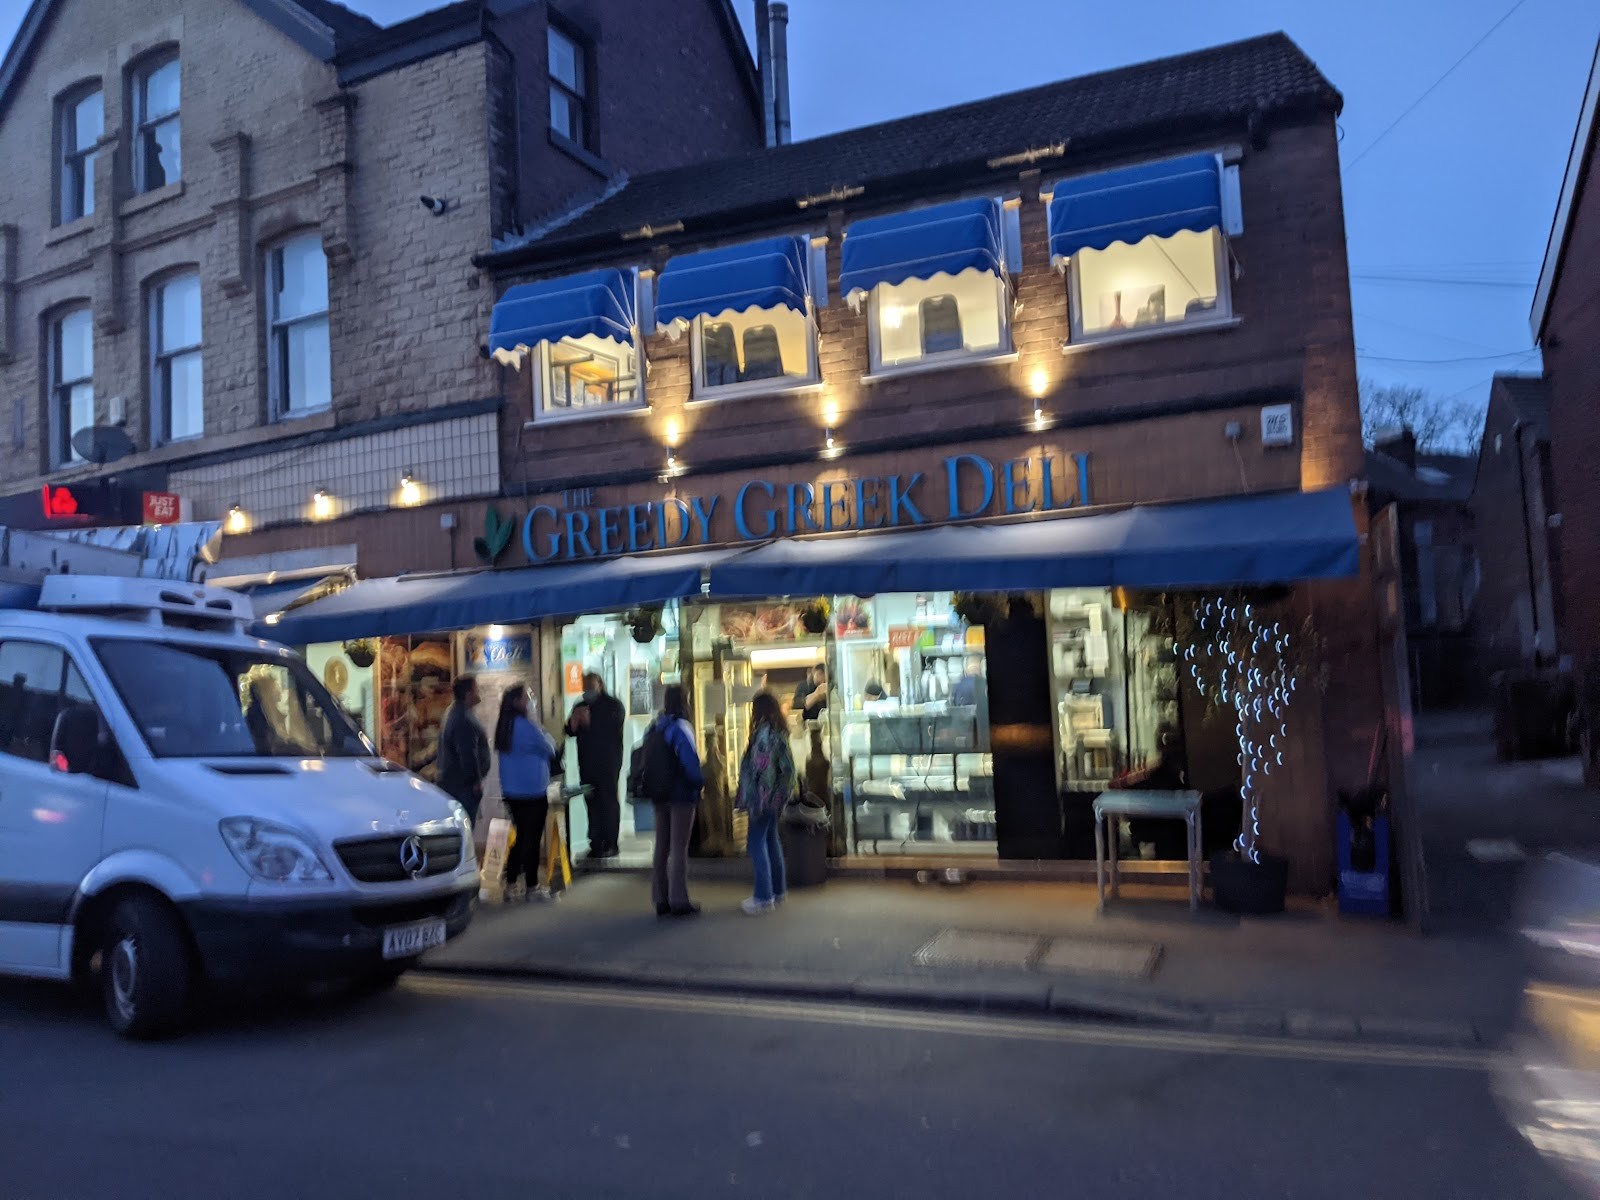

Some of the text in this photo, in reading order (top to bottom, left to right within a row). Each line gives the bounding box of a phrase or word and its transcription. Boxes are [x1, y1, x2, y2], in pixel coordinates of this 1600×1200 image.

[149, 495, 175, 507] JUST
[522, 451, 1092, 562] GREEDY GREEK DELI
[154, 505, 175, 517] EAT
